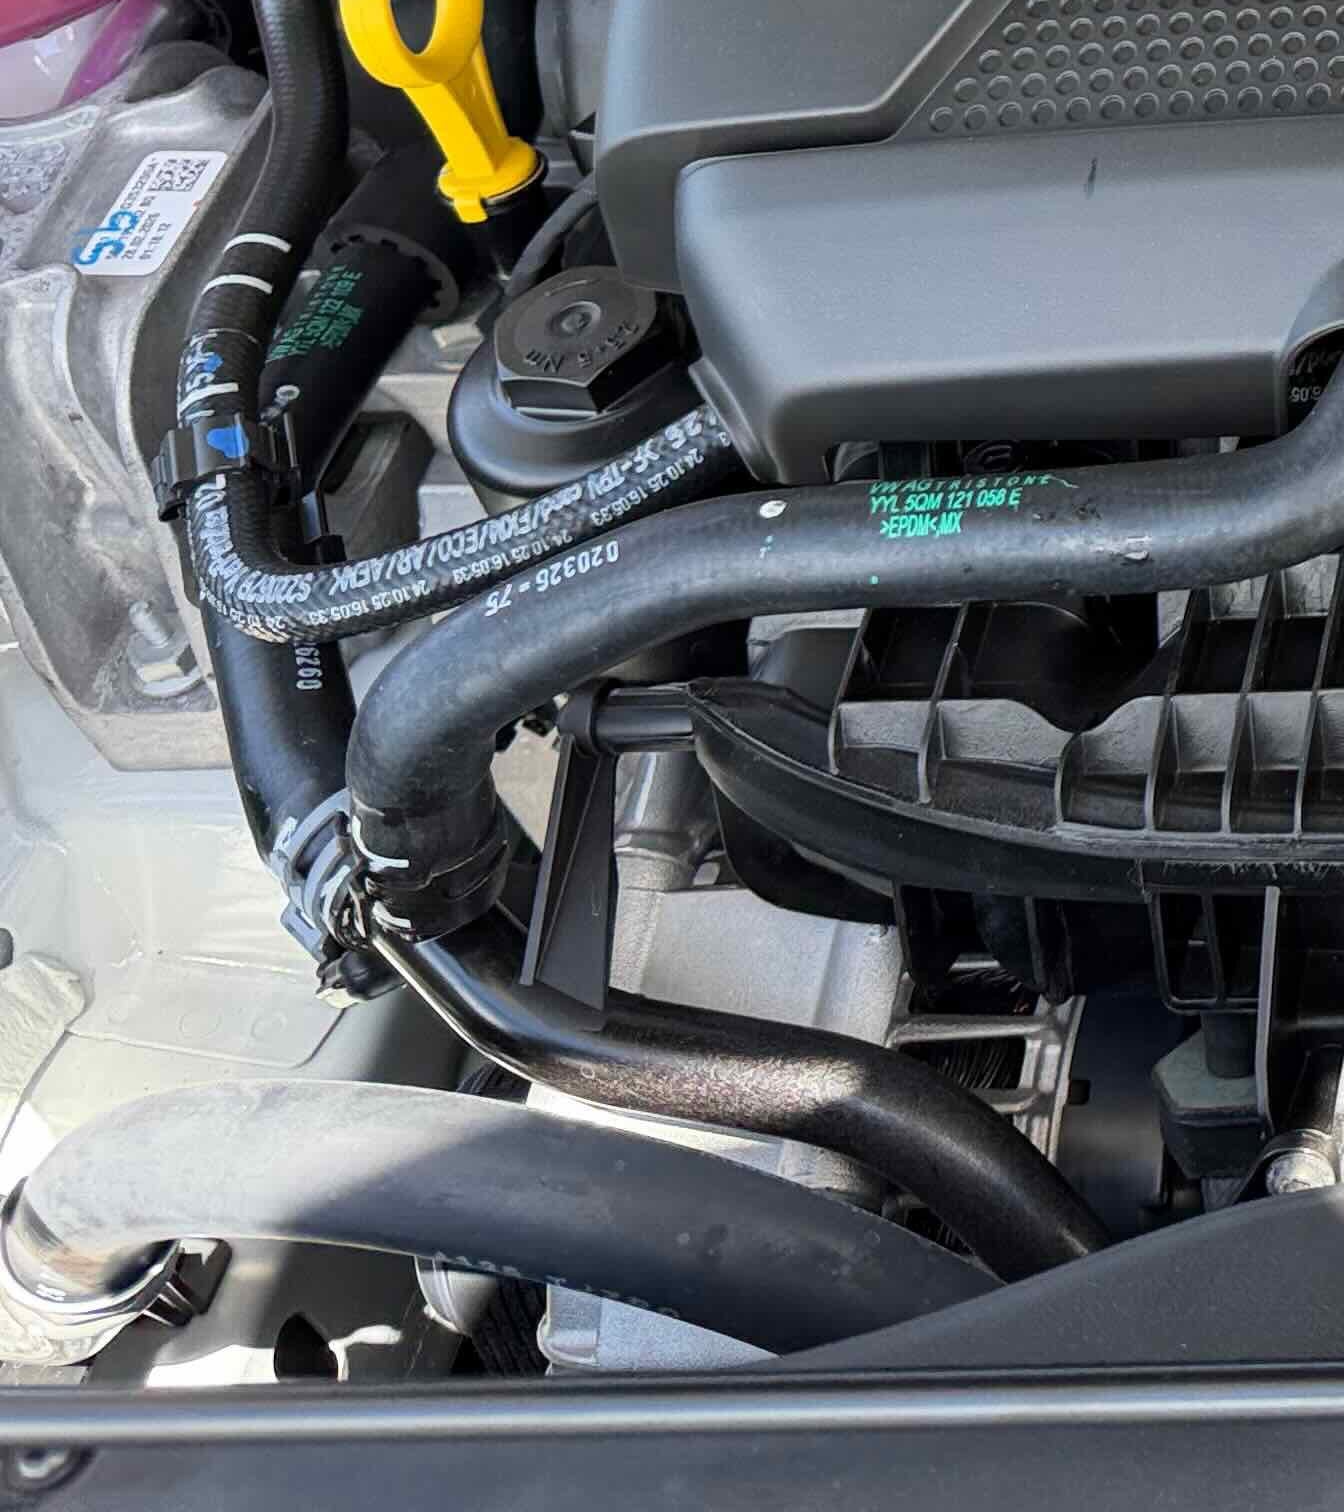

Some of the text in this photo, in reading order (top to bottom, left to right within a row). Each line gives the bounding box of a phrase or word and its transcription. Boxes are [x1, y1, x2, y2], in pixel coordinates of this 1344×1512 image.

[933, 471, 1052, 491] TRISTONE
[904, 491, 942, 512] 5QM
[947, 489, 973, 509] 121
[1009, 487, 1023, 508] E
[535, 540, 621, 584] 020326
